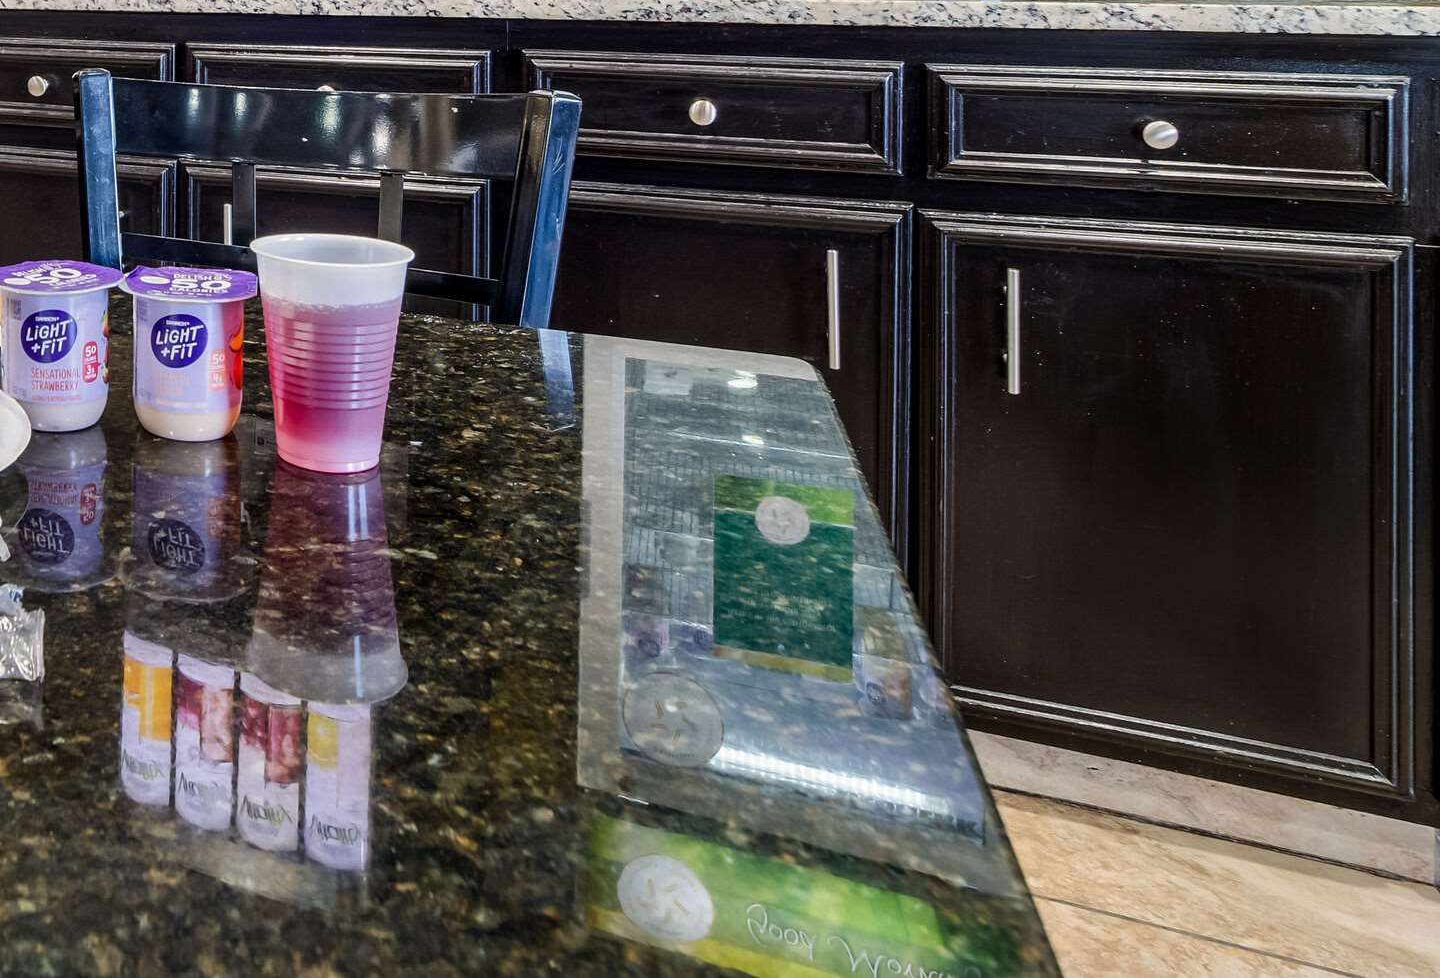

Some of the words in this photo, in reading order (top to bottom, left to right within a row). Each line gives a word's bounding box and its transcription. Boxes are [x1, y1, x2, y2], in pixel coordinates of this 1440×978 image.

[171, 278, 231, 290] 50
[85, 346, 96, 357] 50
[31, 368, 80, 379] SENSATIONAL
[31, 381, 78, 391] STRAWBERRY
